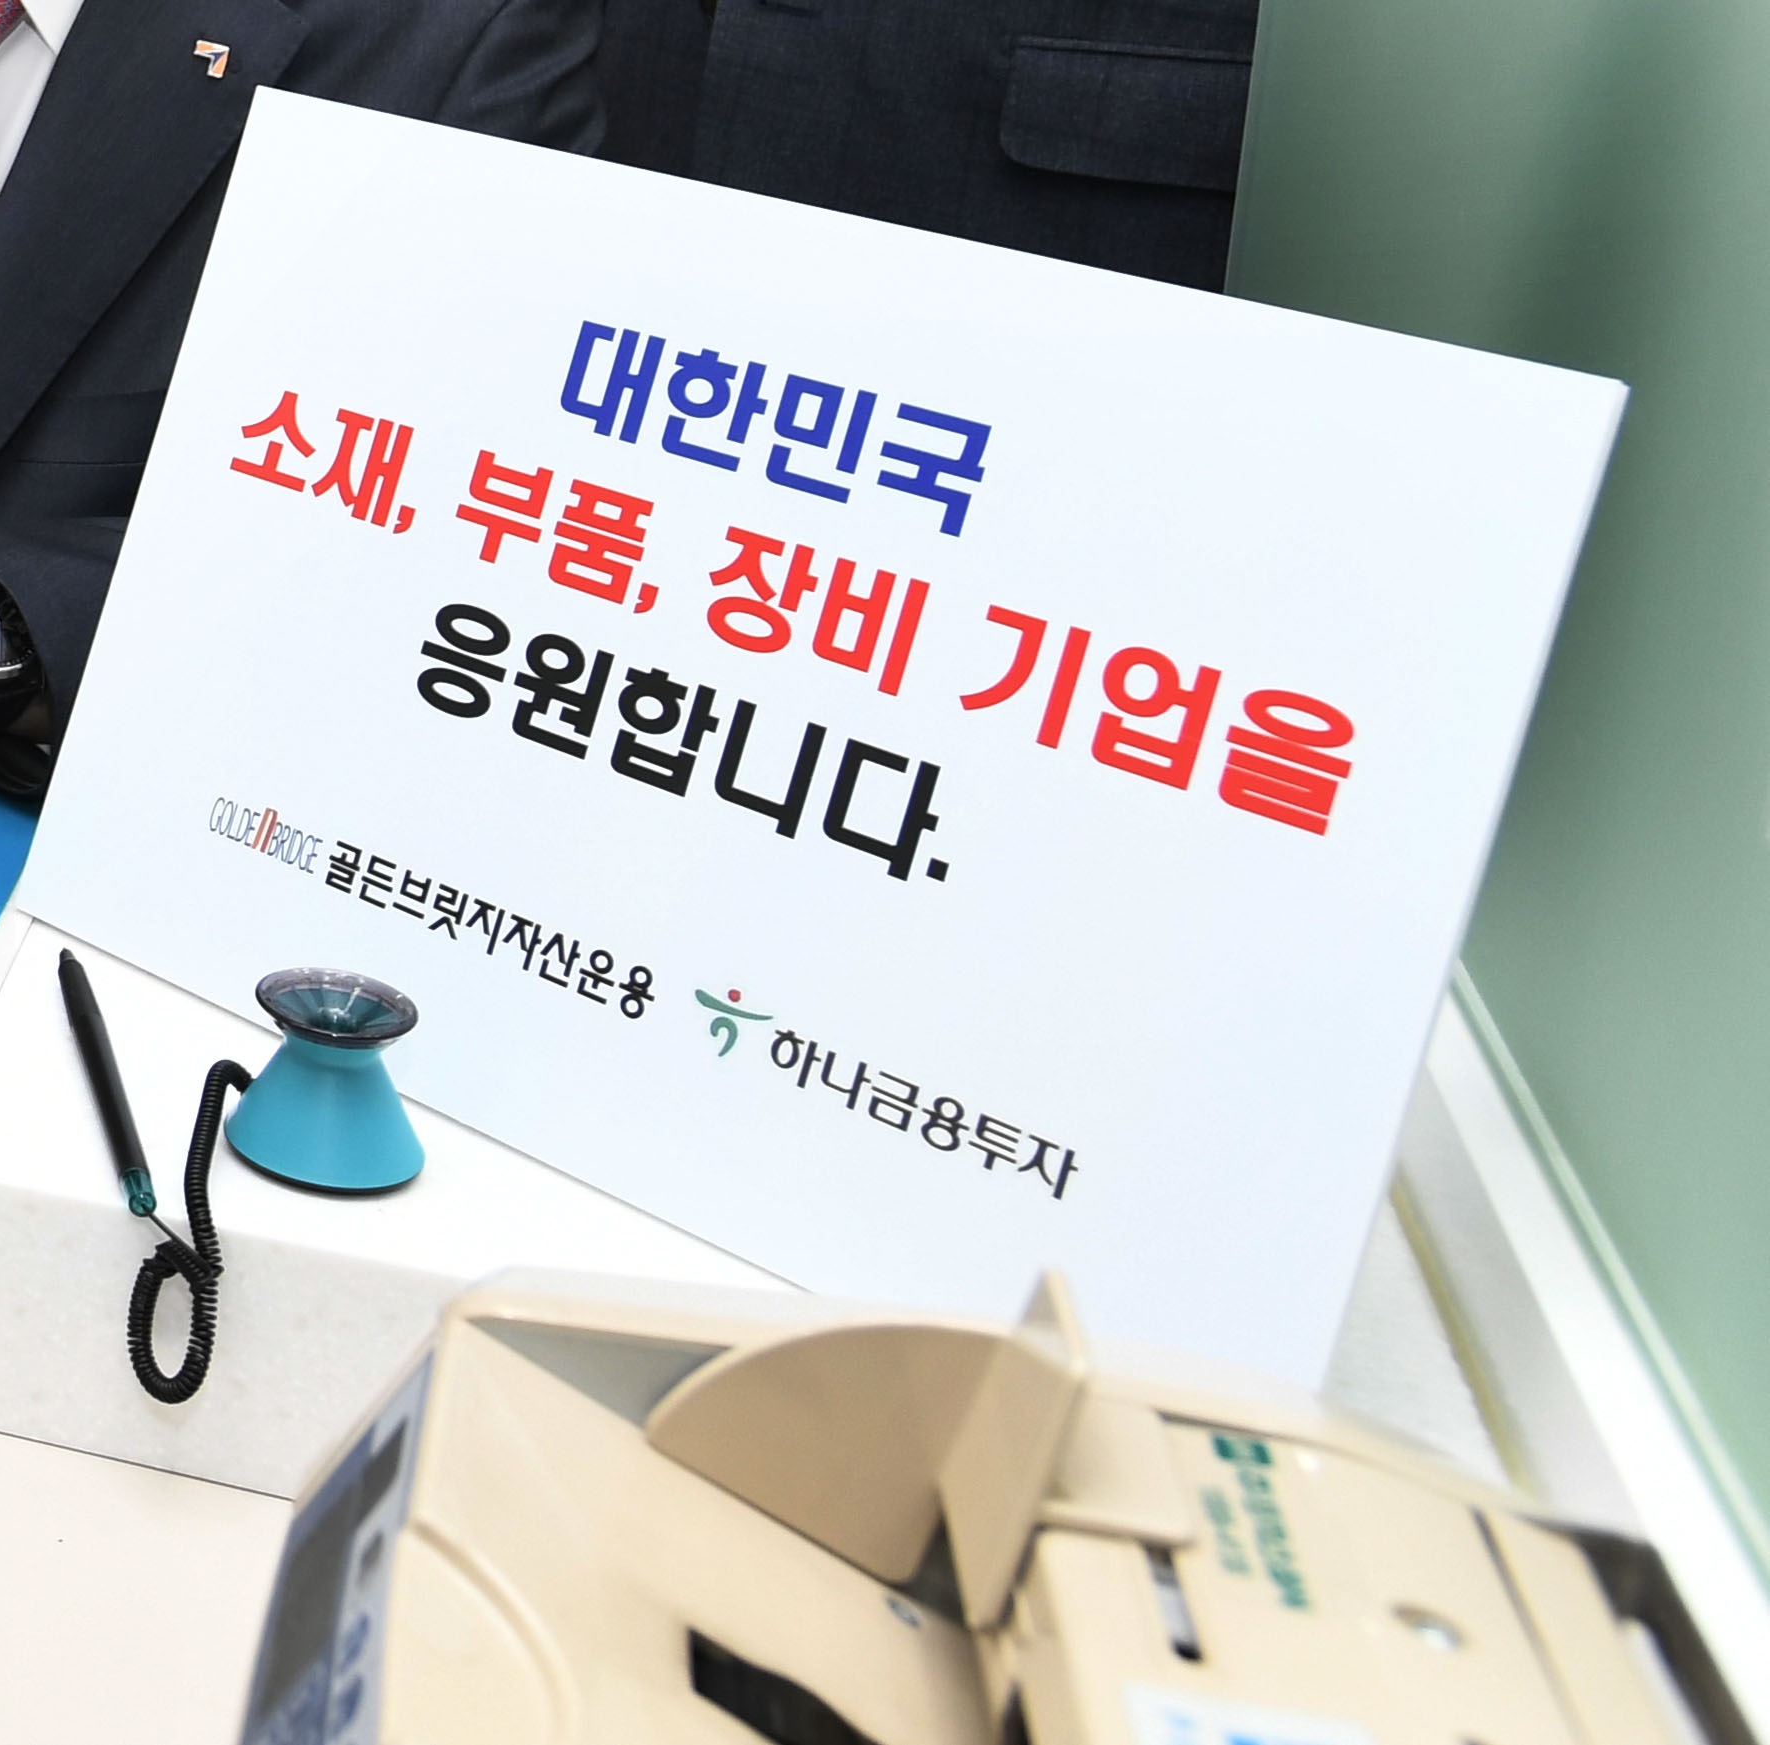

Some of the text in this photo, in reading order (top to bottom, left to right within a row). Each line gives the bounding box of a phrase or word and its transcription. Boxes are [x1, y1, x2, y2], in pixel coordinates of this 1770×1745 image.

[560, 319, 994, 538] 대한민국
[229, 389, 1355, 837] 소재, 부품, 장비 기업을
[416, 602, 950, 883] 응원합니다.
[324, 839, 657, 1020] 골든브릿지자산운용
[768, 1028, 1079, 1201] 하나금융투자
